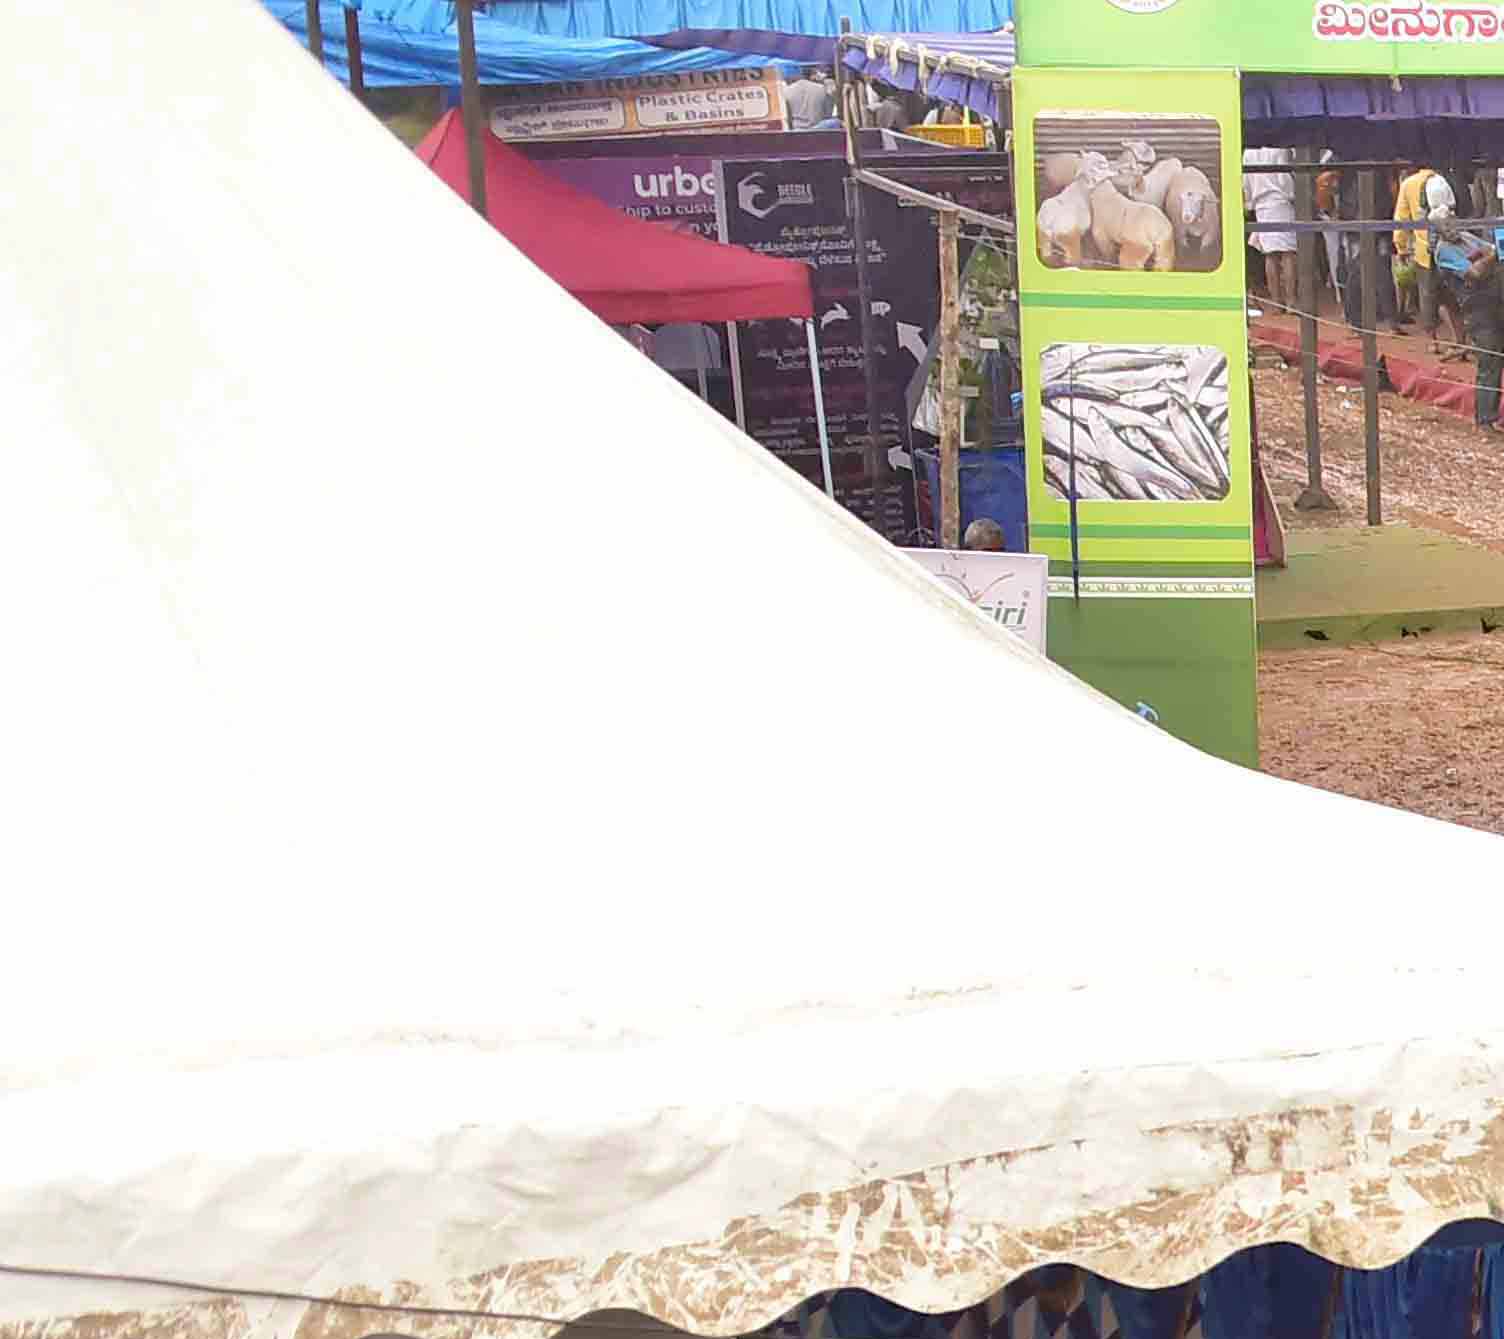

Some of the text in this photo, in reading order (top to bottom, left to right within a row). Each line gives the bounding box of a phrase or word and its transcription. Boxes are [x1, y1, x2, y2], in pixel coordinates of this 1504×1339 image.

[639, 88, 765, 108] Plastic Crates
[685, 107, 745, 120] Basins
